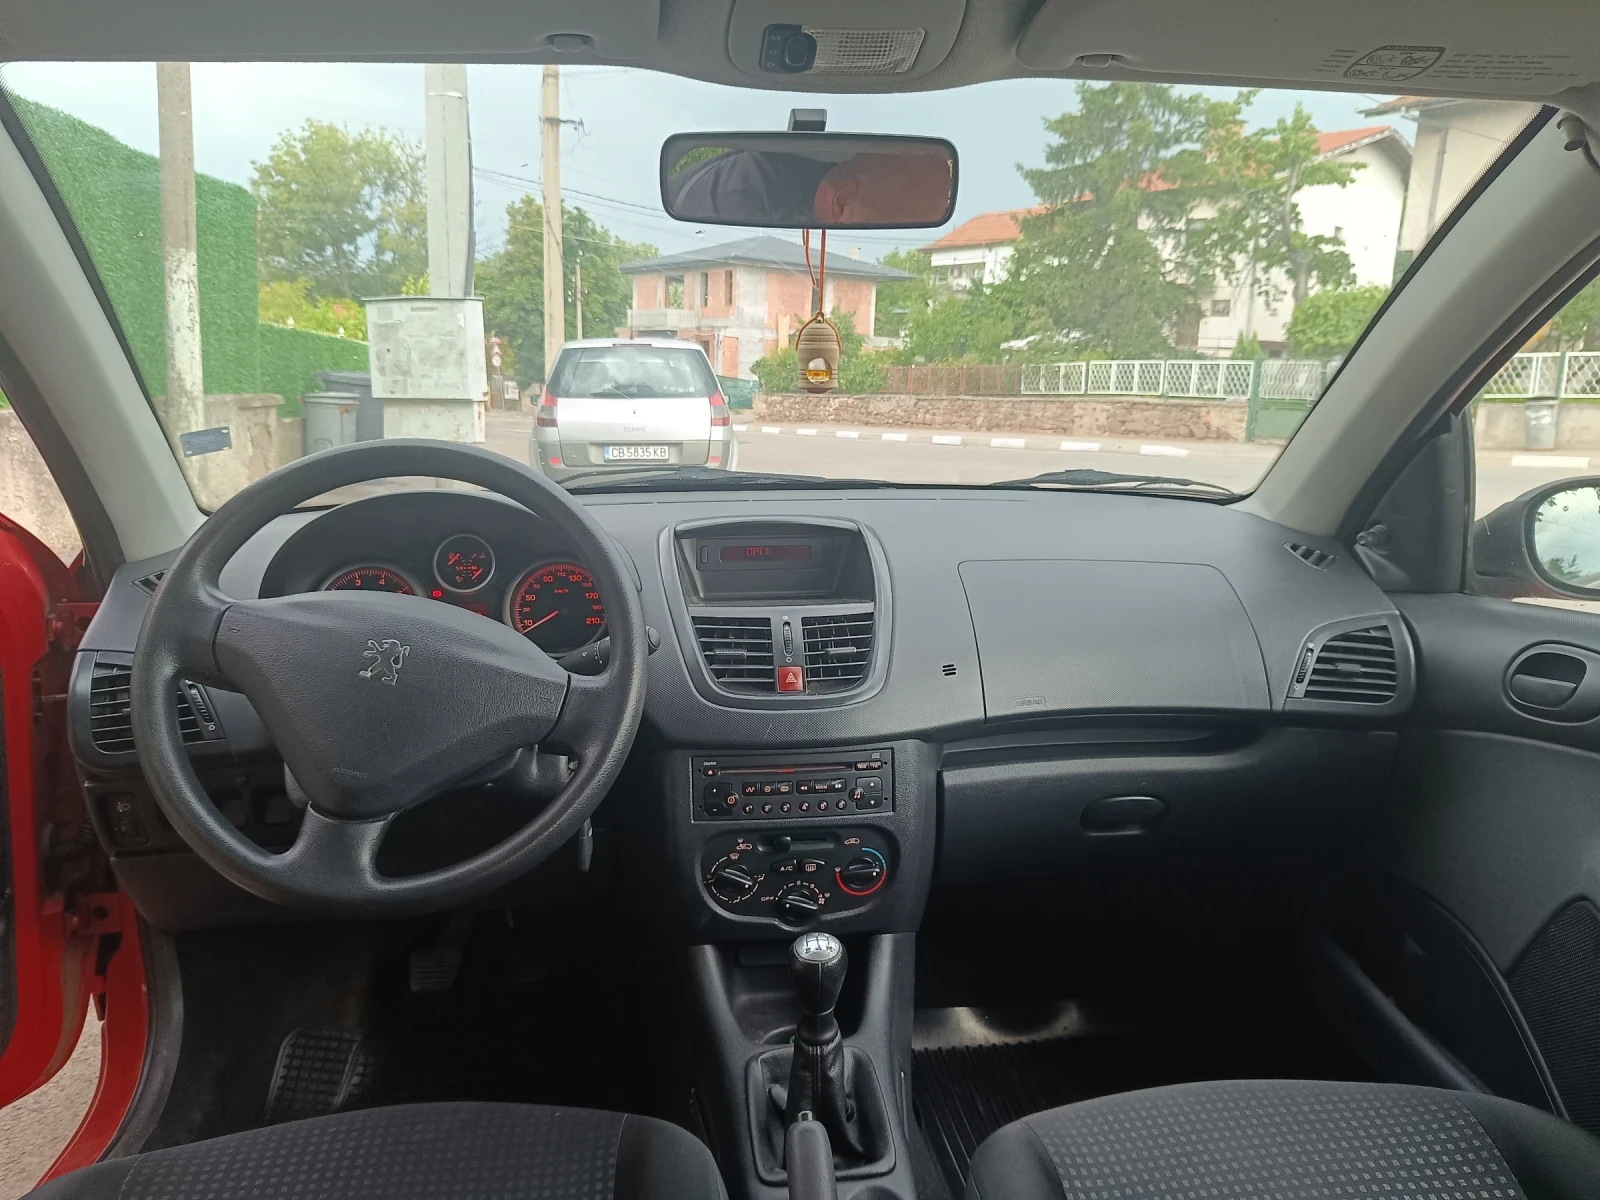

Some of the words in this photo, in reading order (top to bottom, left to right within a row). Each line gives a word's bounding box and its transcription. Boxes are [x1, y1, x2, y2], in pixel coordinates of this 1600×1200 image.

[611, 447, 625, 458] CB
[626, 447, 651, 458] 5835
[653, 447, 667, 458] KB
[1014, 698, 1045, 707] AIRBAG
